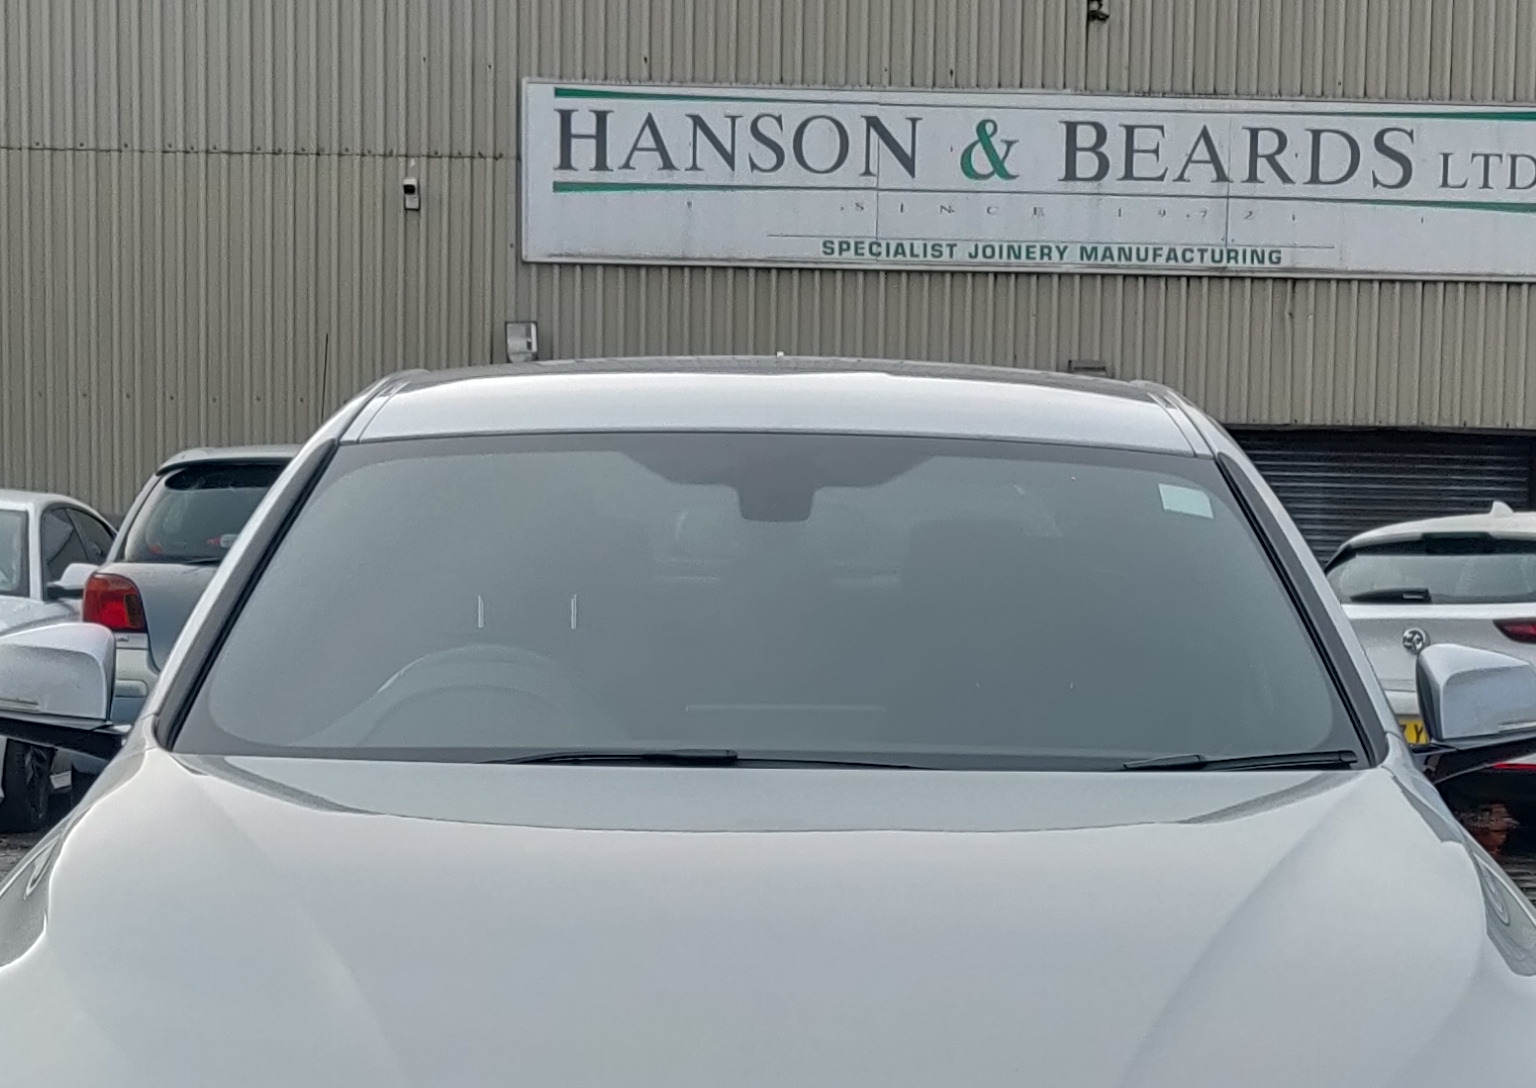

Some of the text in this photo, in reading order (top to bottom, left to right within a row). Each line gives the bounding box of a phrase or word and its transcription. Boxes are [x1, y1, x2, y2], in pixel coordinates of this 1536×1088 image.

[553, 108, 923, 179] HANSON
[960, 119, 1019, 182] &
[1058, 119, 1416, 190] BEARDS
[822, 239, 1283, 266] SPECIALIST JOINERY MANUFACTURING
